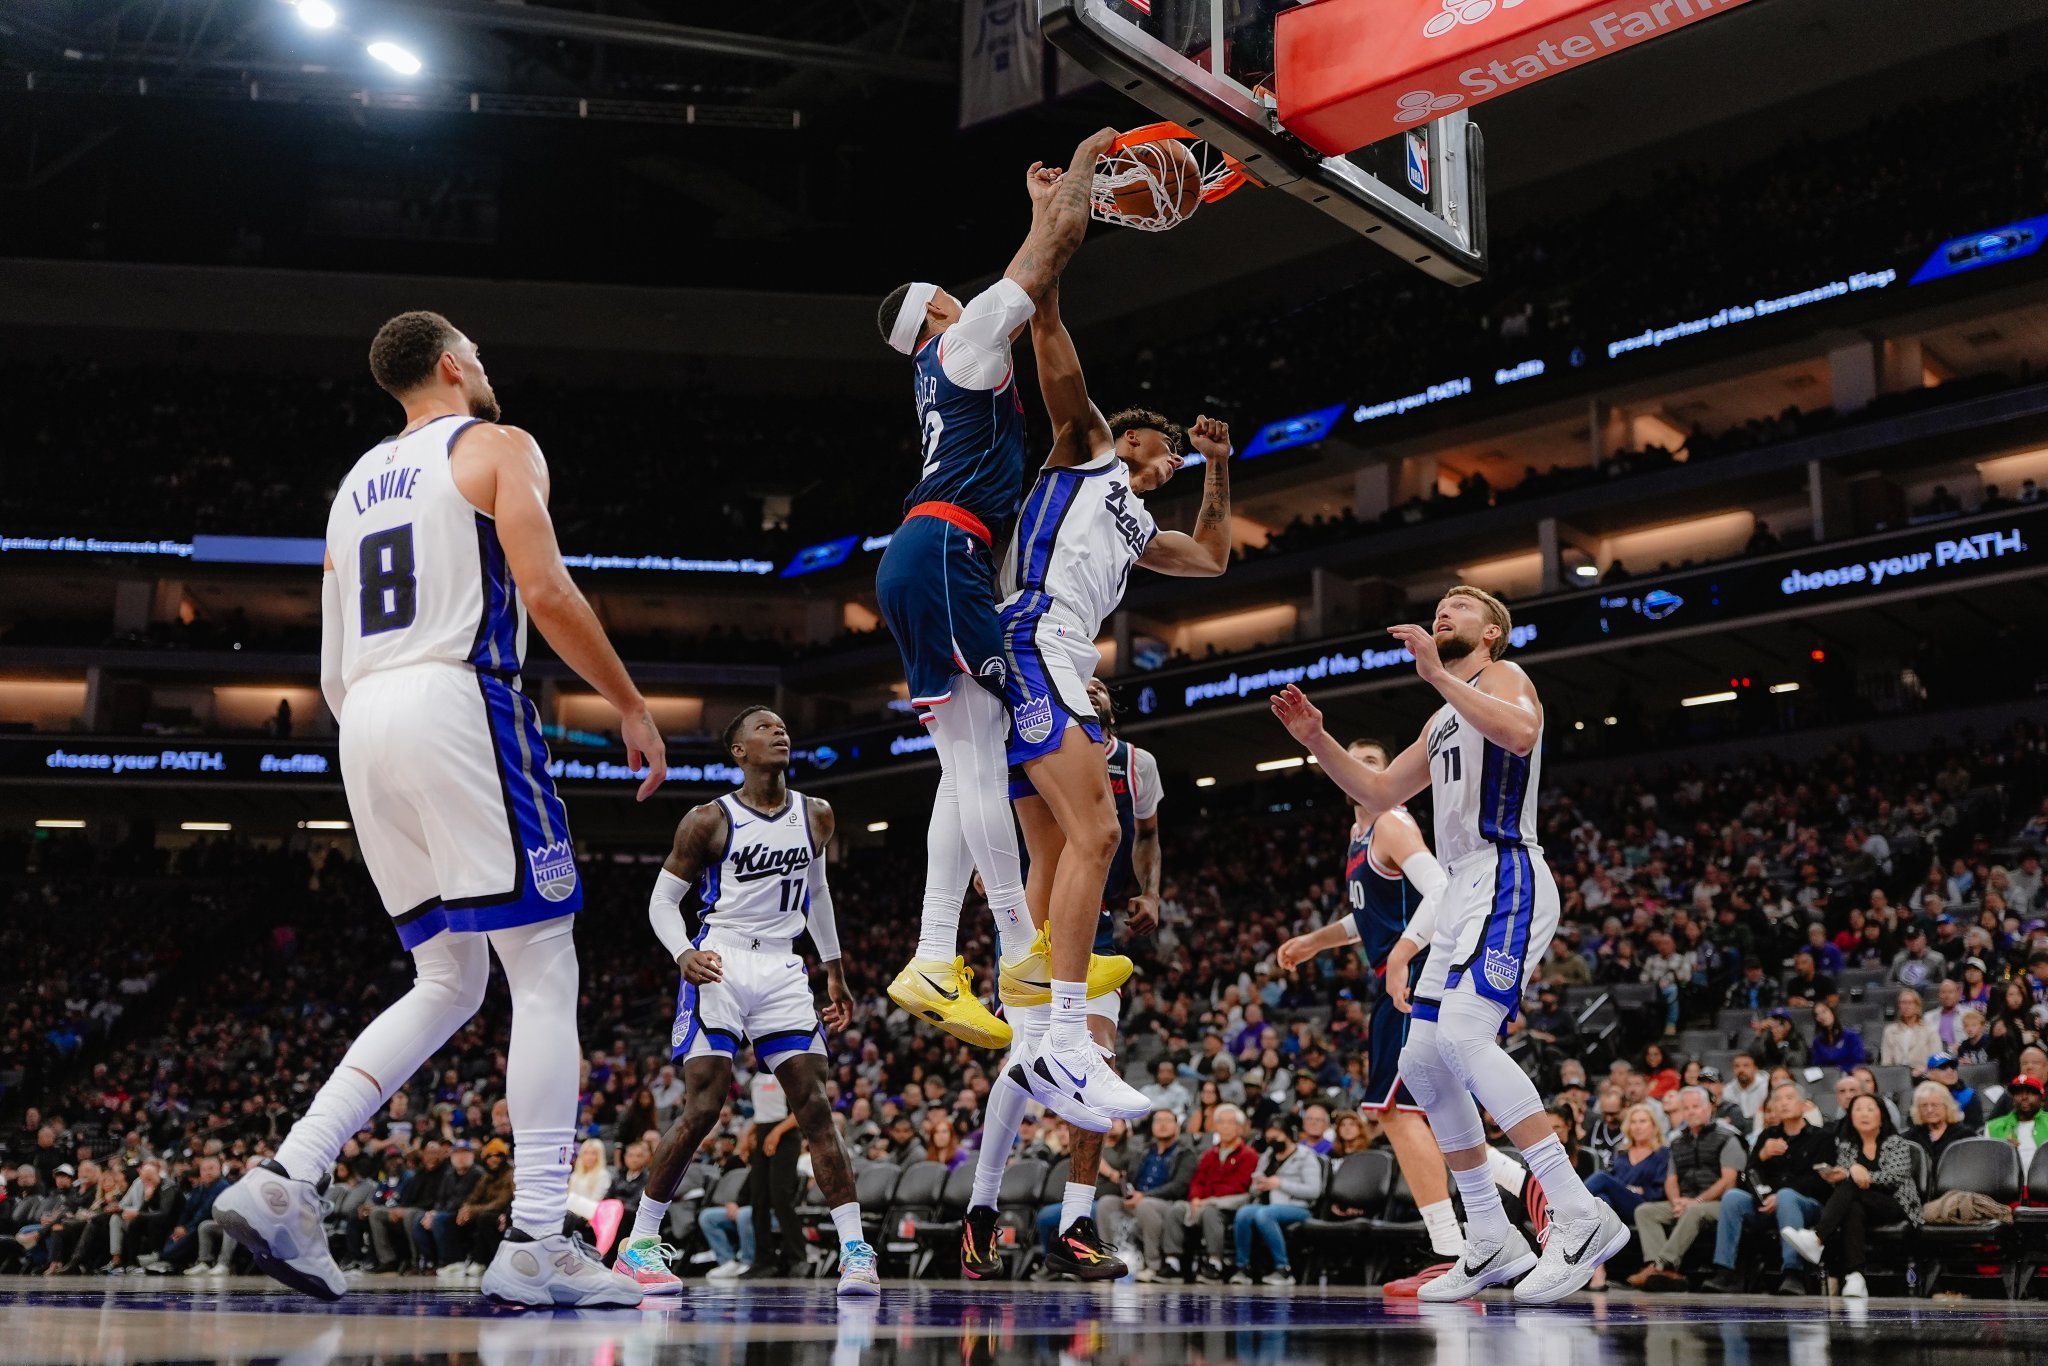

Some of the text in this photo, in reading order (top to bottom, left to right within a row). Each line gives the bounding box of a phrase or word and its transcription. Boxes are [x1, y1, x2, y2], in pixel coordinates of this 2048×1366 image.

[1608, 268, 1896, 358] proud partner of the Sacramento Kings
[352, 467, 421, 515] LAVINE
[360, 522, 417, 638] 8
[1781, 564, 1866, 594] choose
[1868, 551, 1932, 586] your
[1186, 672, 1237, 706] proud
[1239, 665, 1306, 697] partner
[1307, 656, 1328, 680] of
[1329, 653, 1360, 675] the
[1018, 713, 1051, 731] KINGS
[46, 749, 112, 769] choose
[112, 753, 159, 773] your
[565, 759, 595, 779] the
[1442, 746, 1461, 784] 11
[536, 863, 574, 884] KINGS
[731, 843, 810, 882] Kings
[1486, 962, 1517, 981] KINGS
